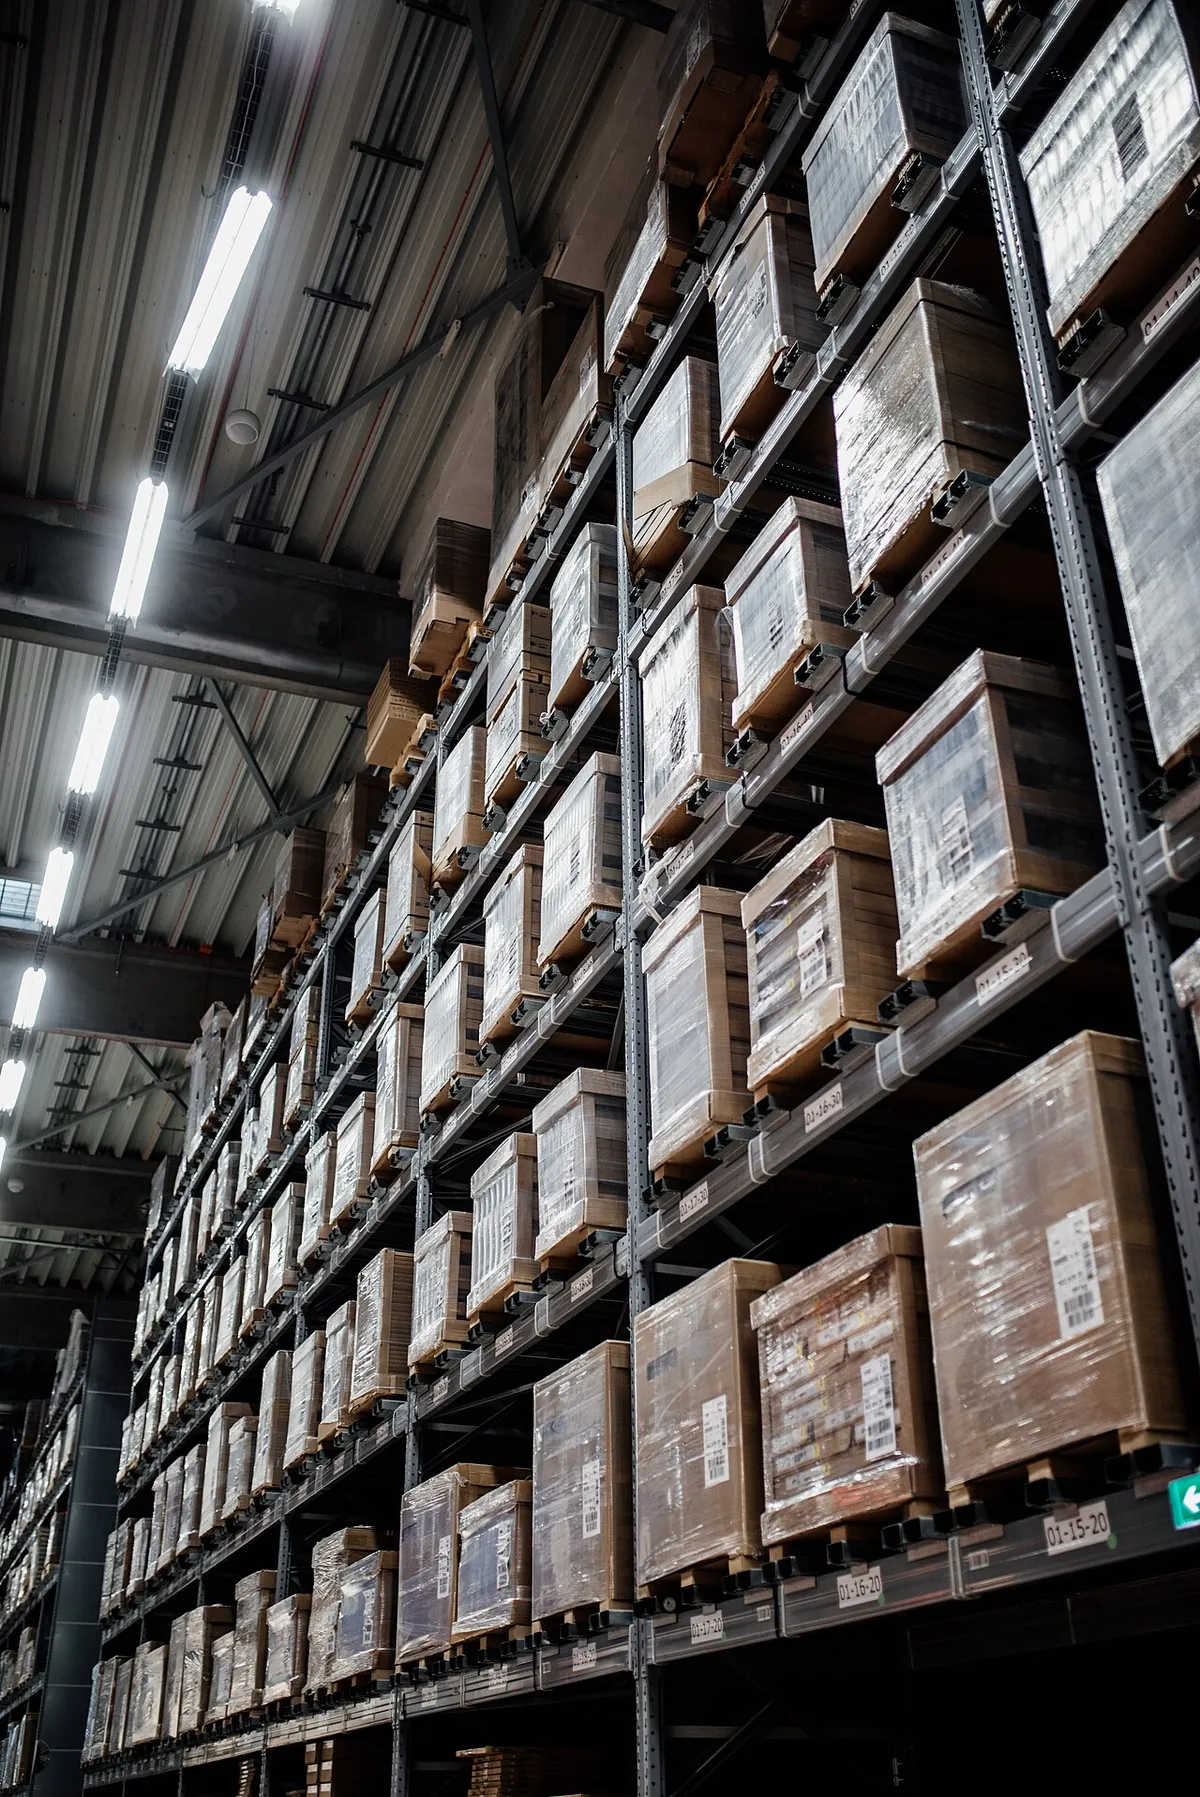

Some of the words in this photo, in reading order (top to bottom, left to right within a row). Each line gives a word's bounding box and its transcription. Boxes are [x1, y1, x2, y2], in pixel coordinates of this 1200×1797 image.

[806, 1091, 841, 1126] 01-16-30
[681, 1188, 708, 1216] 01-17-30
[1047, 1512, 1108, 1547] 01-15-20
[839, 1575, 881, 1601] 01-16-20
[691, 1617, 723, 1638] 01-17-20
